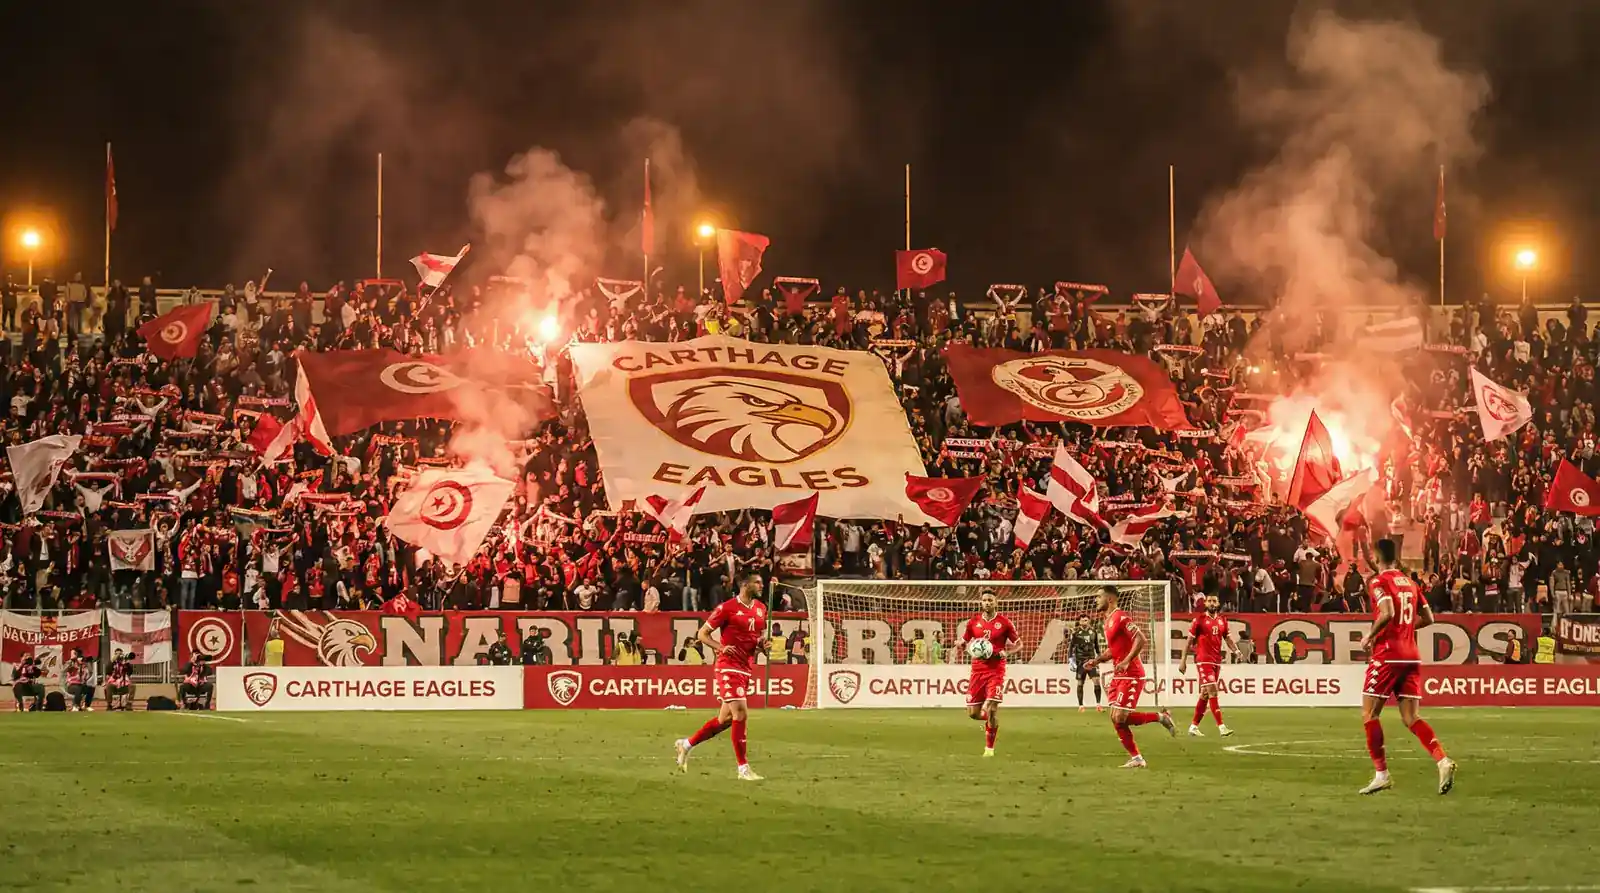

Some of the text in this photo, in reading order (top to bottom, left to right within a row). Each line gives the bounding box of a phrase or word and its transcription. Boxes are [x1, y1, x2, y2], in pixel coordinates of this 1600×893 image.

[612, 346, 850, 377] CARTHAGE
[652, 462, 873, 491] EAGLES
[1397, 592, 1414, 625] 15
[286, 680, 496, 698] CARTHAGE EAGLES
[589, 678, 794, 697] CARTHAGE EGLES
[869, 678, 1071, 695] CARTHAG AGLES
[1262, 678, 1341, 695] EAGLES
[1424, 677, 1600, 695] CARTHAGE EAGL
